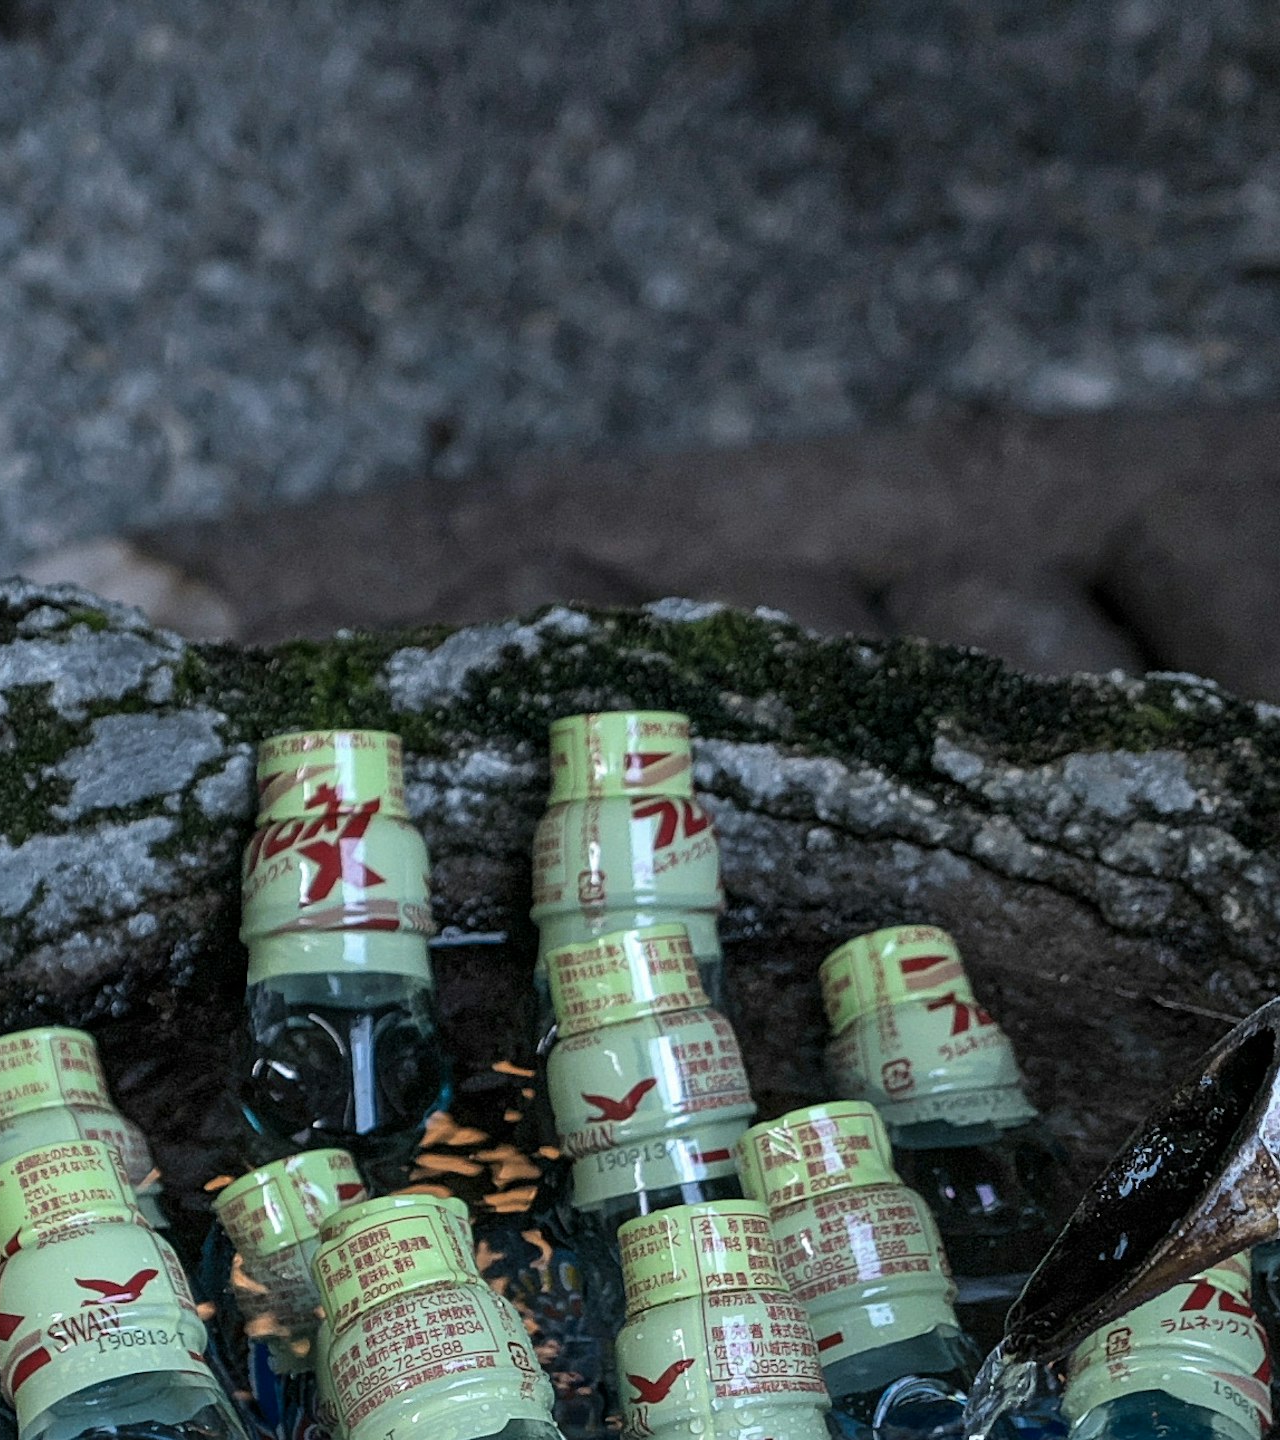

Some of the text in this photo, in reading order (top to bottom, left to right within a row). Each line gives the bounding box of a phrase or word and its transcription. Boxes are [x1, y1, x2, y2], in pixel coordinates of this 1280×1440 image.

[363, 1278, 404, 1303] 200ml
[46, 1306, 120, 1353] SWAN
[1161, 1315, 1253, 1339] ラムネックス
[356, 1340, 464, 1396] 0952-72-5588
